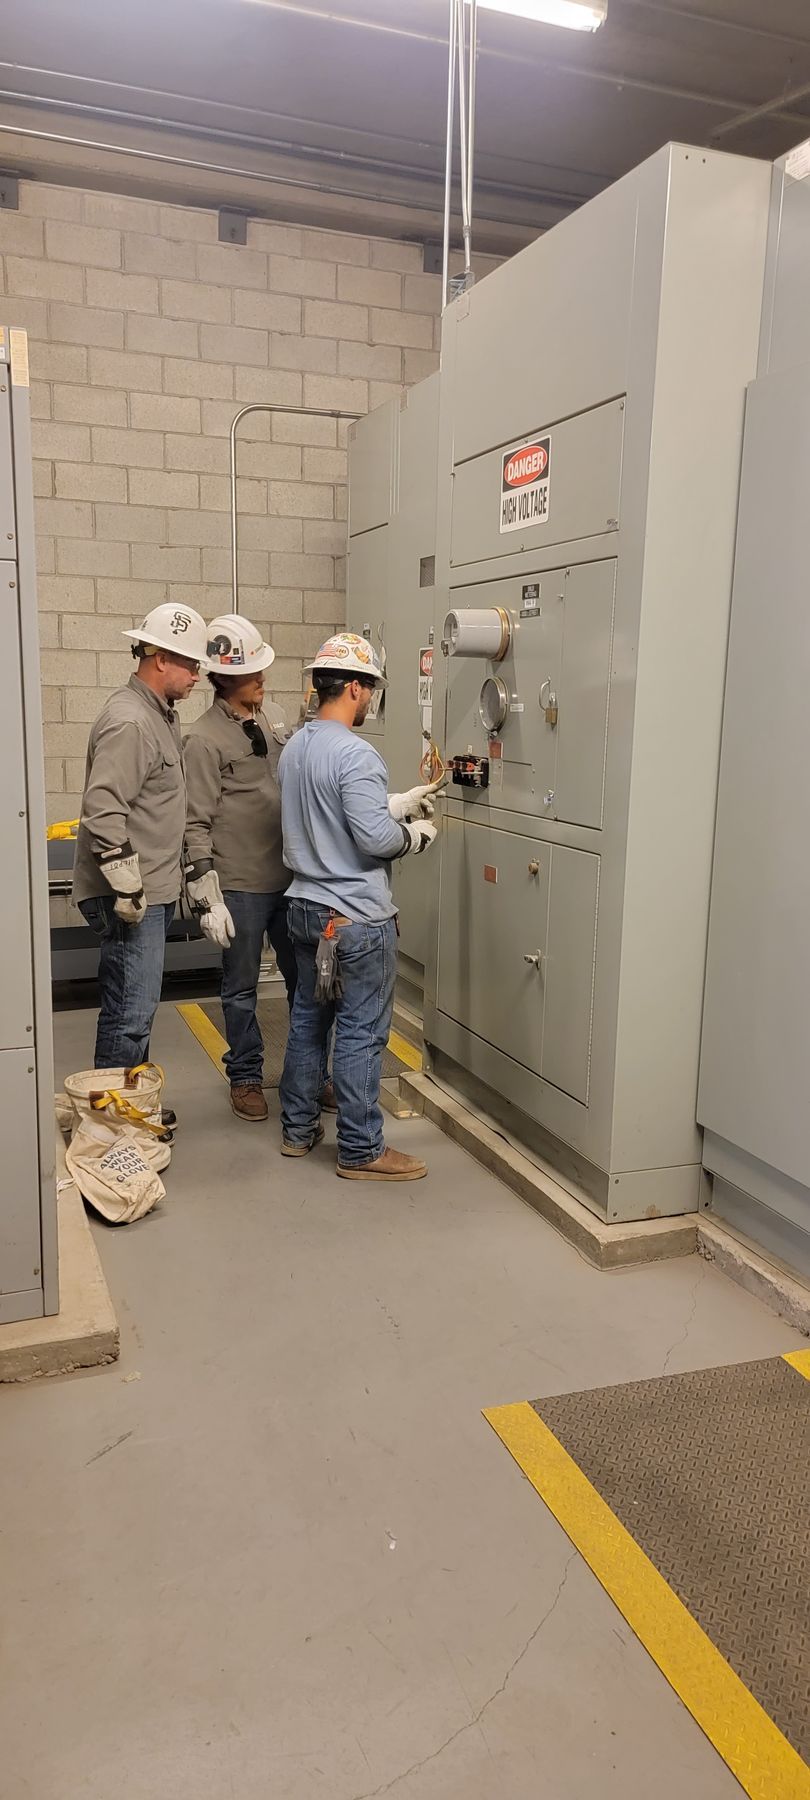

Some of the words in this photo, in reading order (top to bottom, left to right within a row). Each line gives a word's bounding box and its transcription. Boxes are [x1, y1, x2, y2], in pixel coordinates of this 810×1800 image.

[507, 451, 544, 481] DANGER
[502, 496, 517, 526] HIGH
[518, 486, 547, 521] VOLTAGE
[100, 1145, 137, 1170] ALWAYS
[108, 1152, 139, 1170] WEAR
[115, 1157, 145, 1173] YOUR
